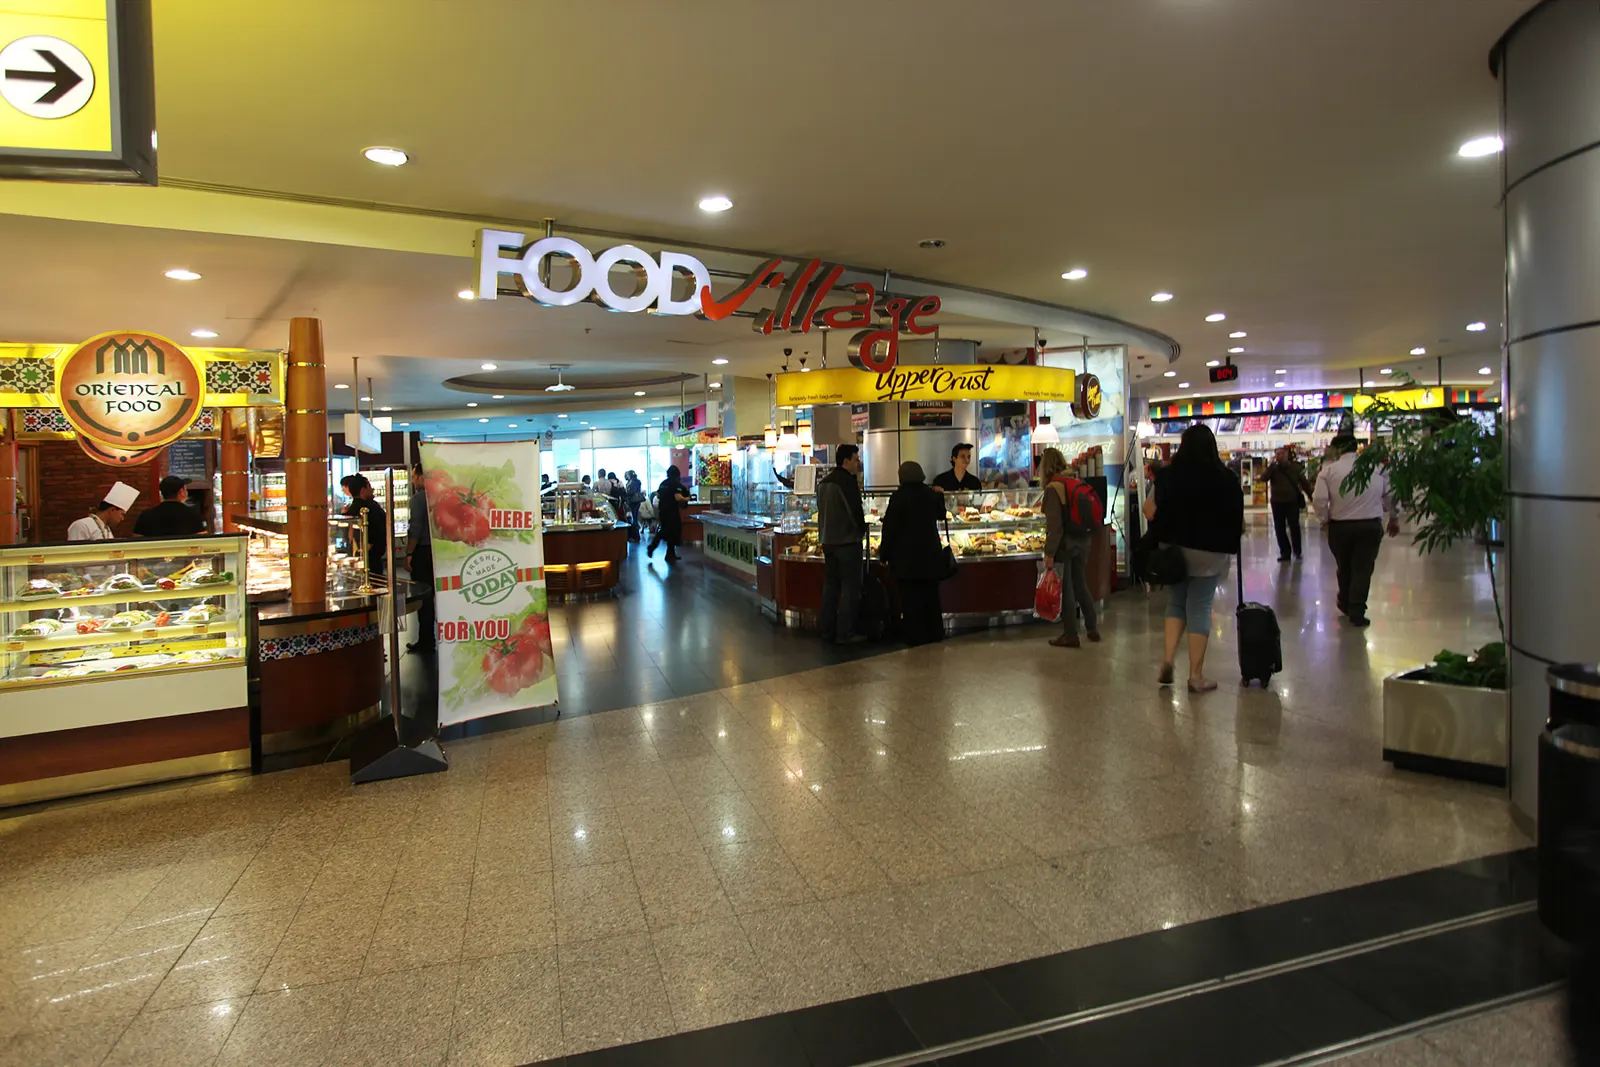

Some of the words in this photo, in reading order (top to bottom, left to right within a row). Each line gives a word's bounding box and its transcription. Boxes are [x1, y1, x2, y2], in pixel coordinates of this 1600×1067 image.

[476, 227, 710, 317] FOOD
[75, 381, 187, 397] ORIENTAL
[875, 367, 944, 400] Upper
[932, 366, 994, 394] Crust
[105, 399, 162, 416] FOOD
[1240, 396, 1280, 412] DUTY
[1284, 393, 1324, 411] FREE
[490, 509, 533, 529] HERE
[466, 554, 502, 576] FRESHLY
[475, 564, 497, 577] MADE
[458, 566, 519, 603] TODAY
[437, 621, 469, 640] FOR
[474, 620, 509, 640] YOU
